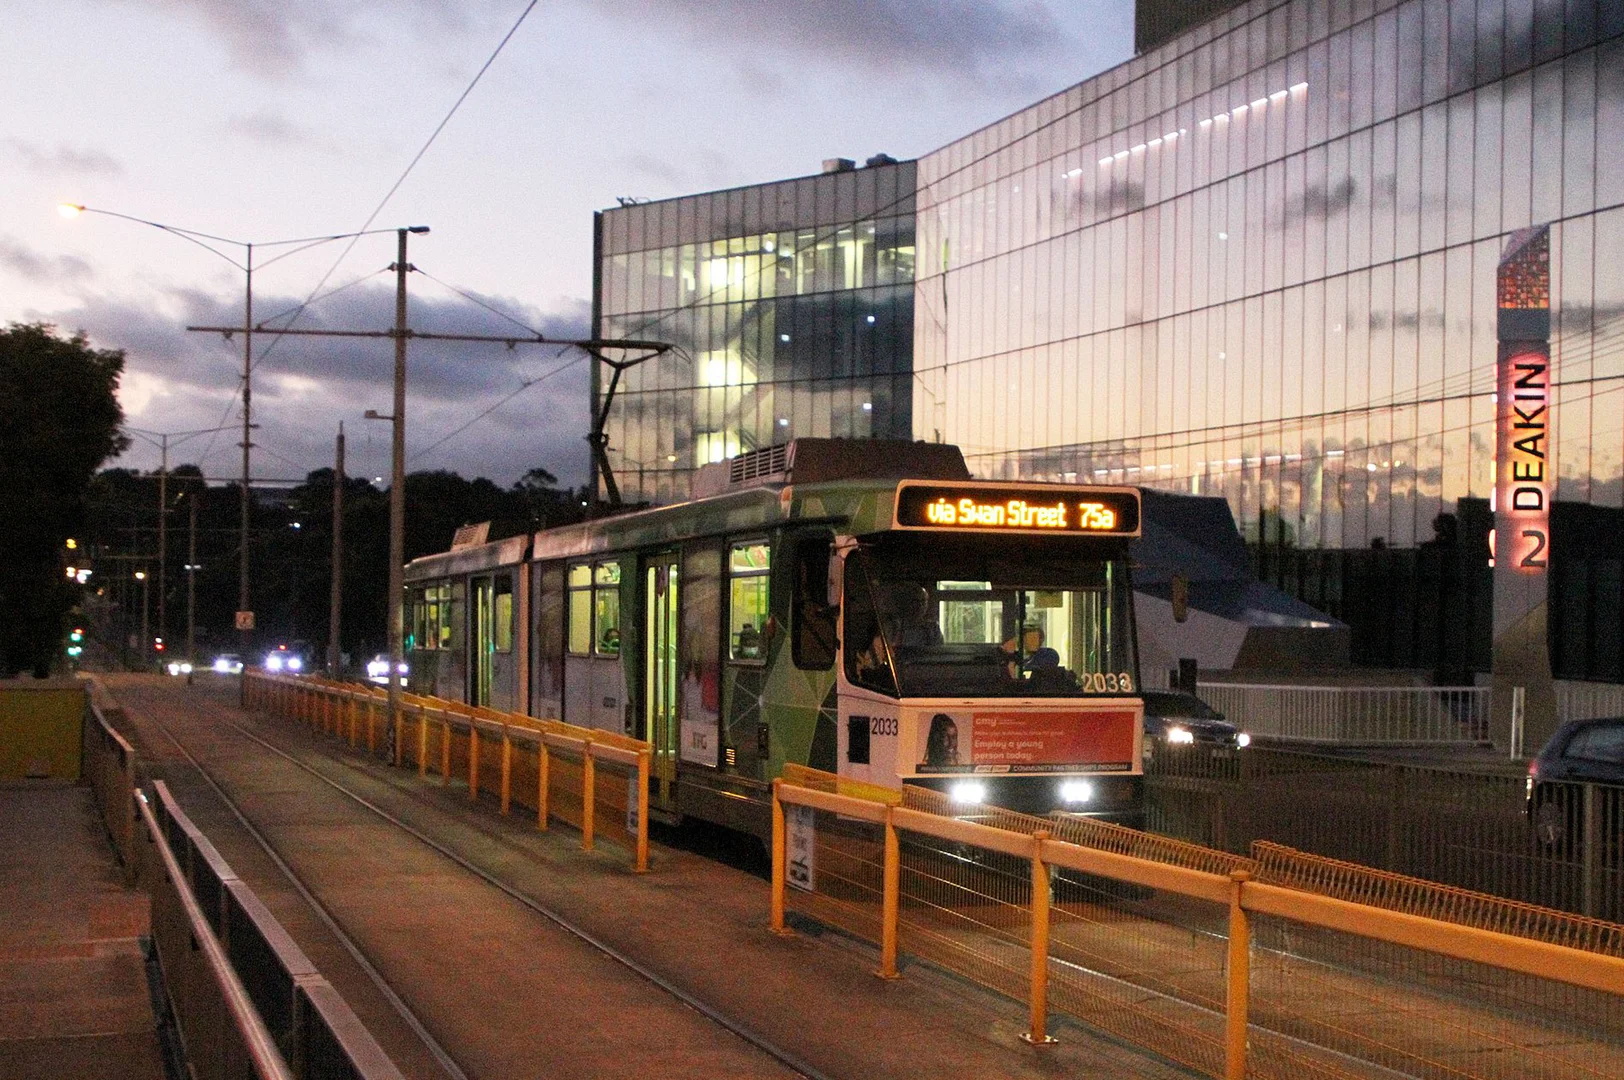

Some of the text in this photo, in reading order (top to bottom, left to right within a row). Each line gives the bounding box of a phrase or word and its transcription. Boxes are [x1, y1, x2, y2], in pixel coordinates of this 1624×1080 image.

[1512, 363, 1546, 511] DEAKIN
[928, 498, 1115, 529] via Swan Street 75a
[1520, 530, 1546, 568] 2
[1081, 672, 1133, 693] 2033
[871, 717, 899, 736] 2033
